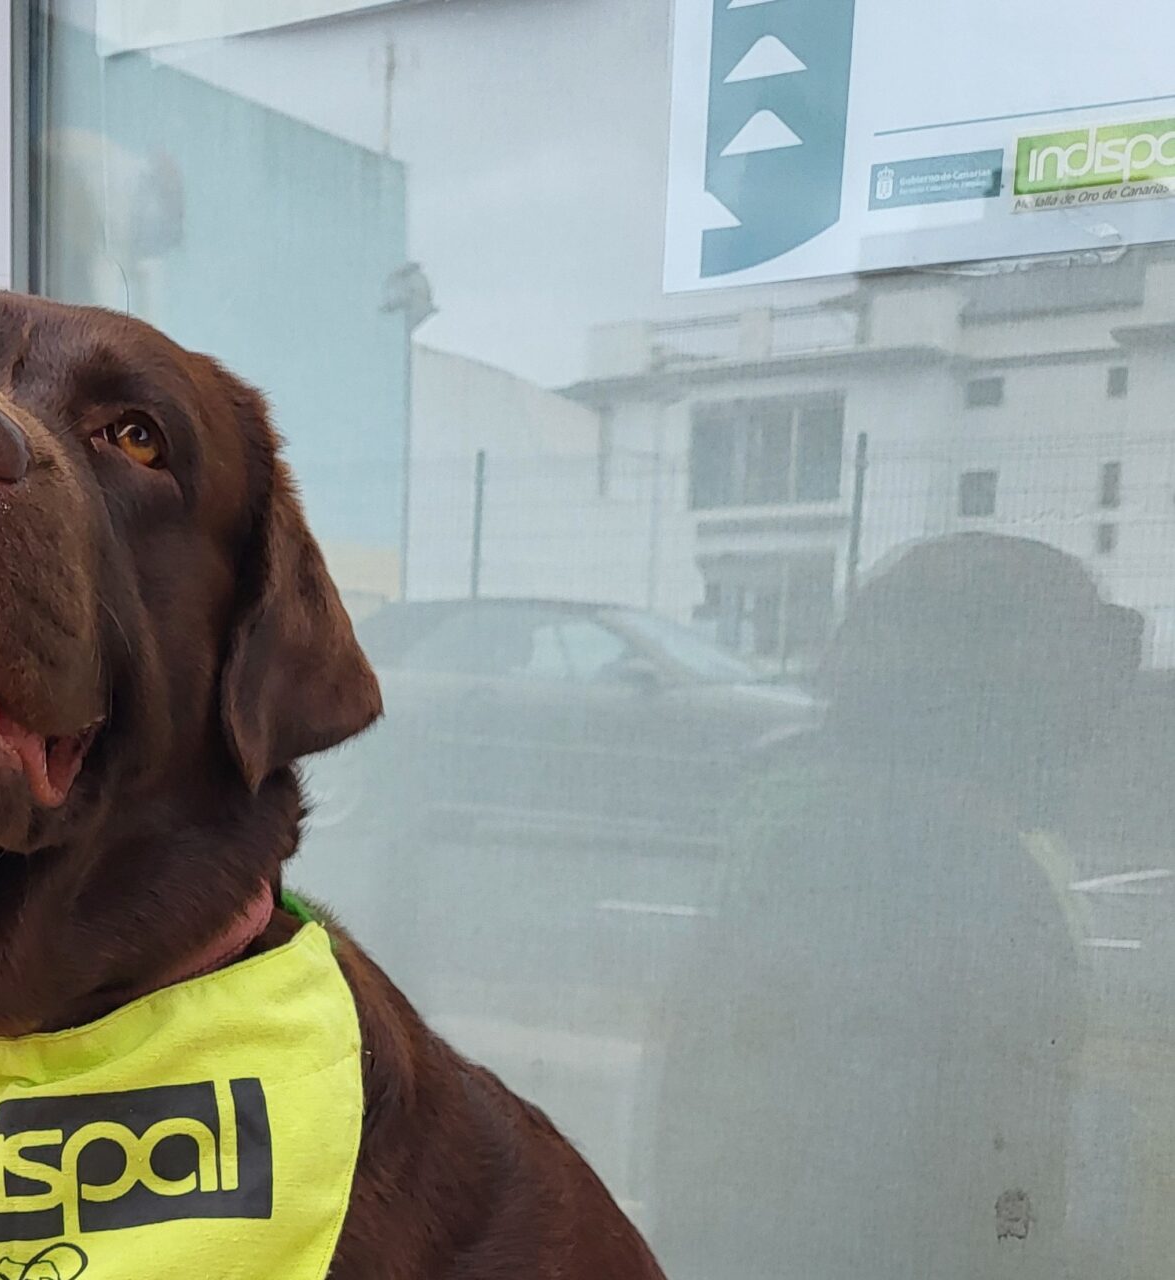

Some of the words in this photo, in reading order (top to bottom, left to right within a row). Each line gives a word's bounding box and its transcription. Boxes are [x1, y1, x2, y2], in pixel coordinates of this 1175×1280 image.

[1078, 190, 1100, 203] Oro
[1103, 187, 1117, 200] de
[1120, 183, 1170, 198] Canarias
